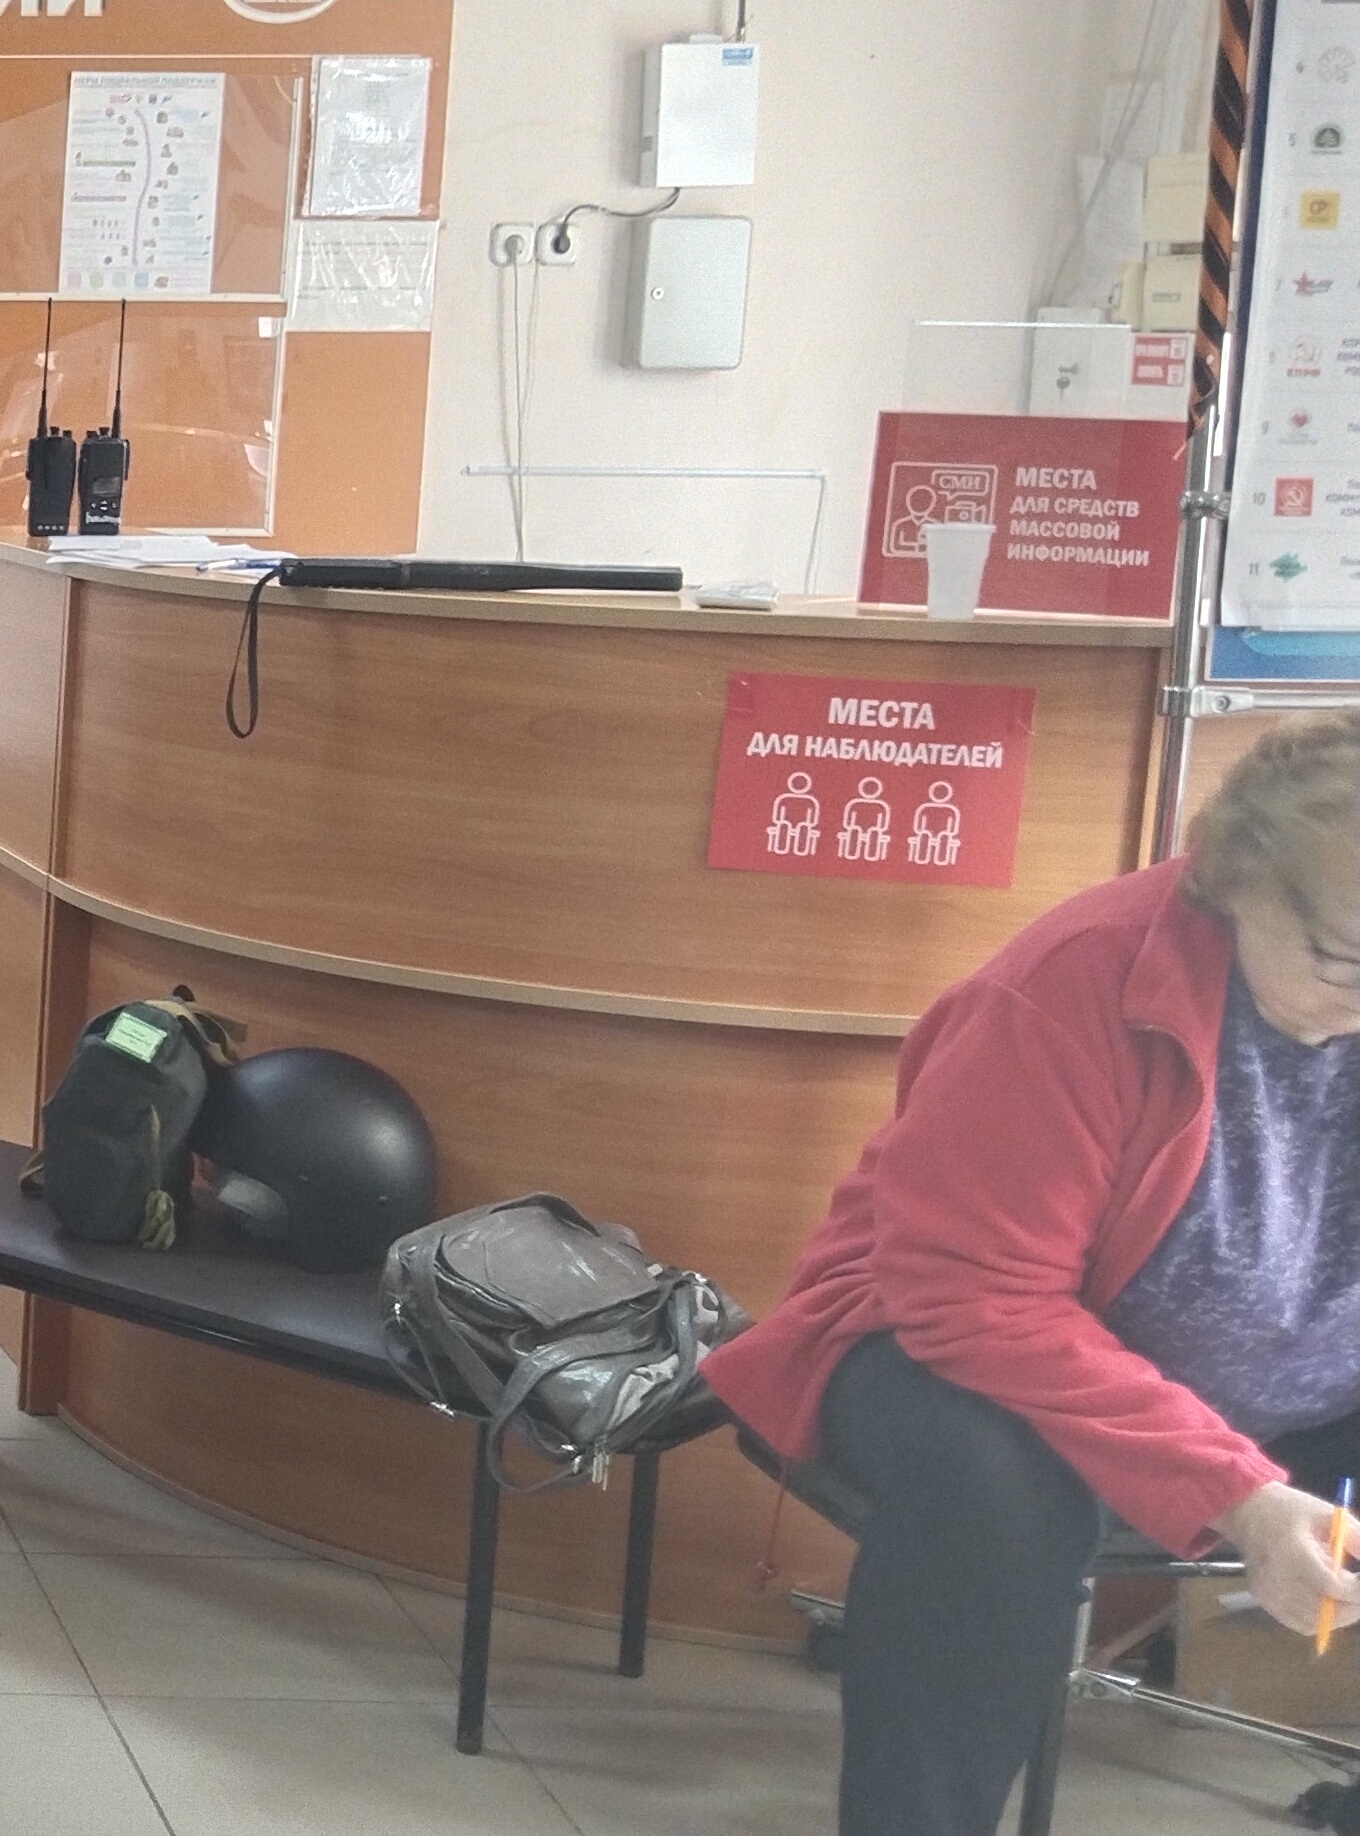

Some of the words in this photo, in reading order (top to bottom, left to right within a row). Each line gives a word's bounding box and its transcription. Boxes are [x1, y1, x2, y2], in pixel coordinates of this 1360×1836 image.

[939, 475, 981, 490] СМИ
[1014, 467, 1098, 491] МЕСТА
[1009, 496, 1049, 515] ДЛЯ
[1053, 498, 1140, 518] СРЕДСТВ
[1009, 519, 1121, 541] МАССОВОЙ
[1007, 543, 1150, 568] ИНФОРМАЦИИ
[828, 697, 936, 730] МЕСТА
[747, 731, 799, 758] ДЛЯ
[805, 736, 1003, 769] НАБЛЮДАТЕЛЕЙ
